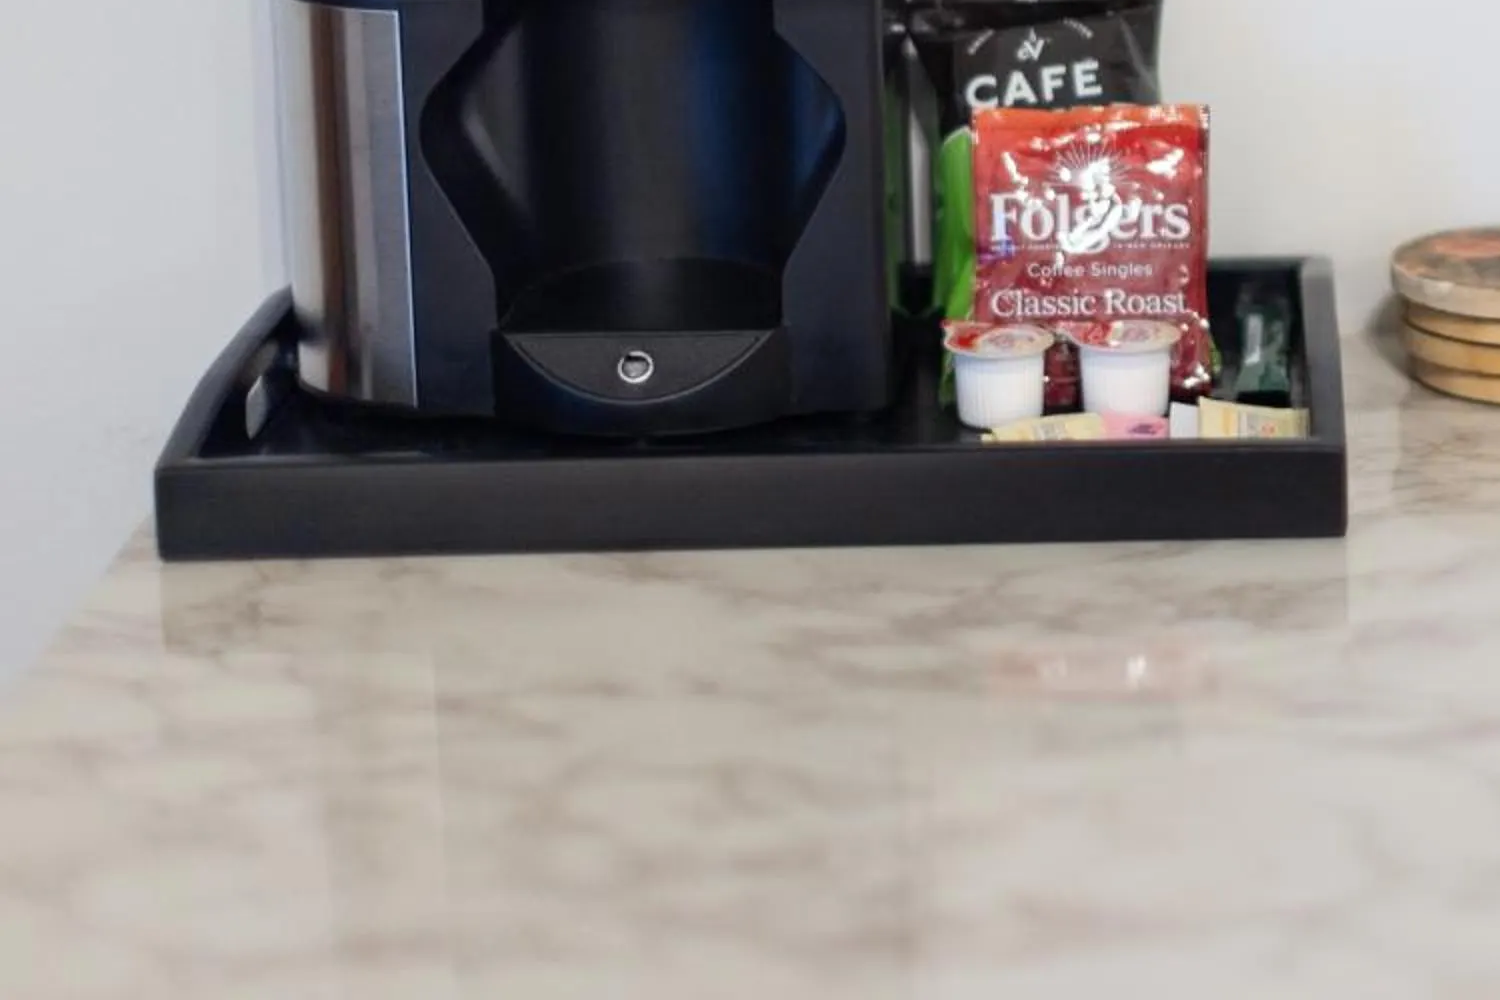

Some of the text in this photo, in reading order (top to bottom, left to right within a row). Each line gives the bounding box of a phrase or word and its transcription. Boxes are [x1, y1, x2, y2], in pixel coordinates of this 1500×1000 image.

[989, 192, 1191, 254] Folgers
[1091, 261, 1153, 280] Singles
[990, 287, 1187, 318] Classic Roast
